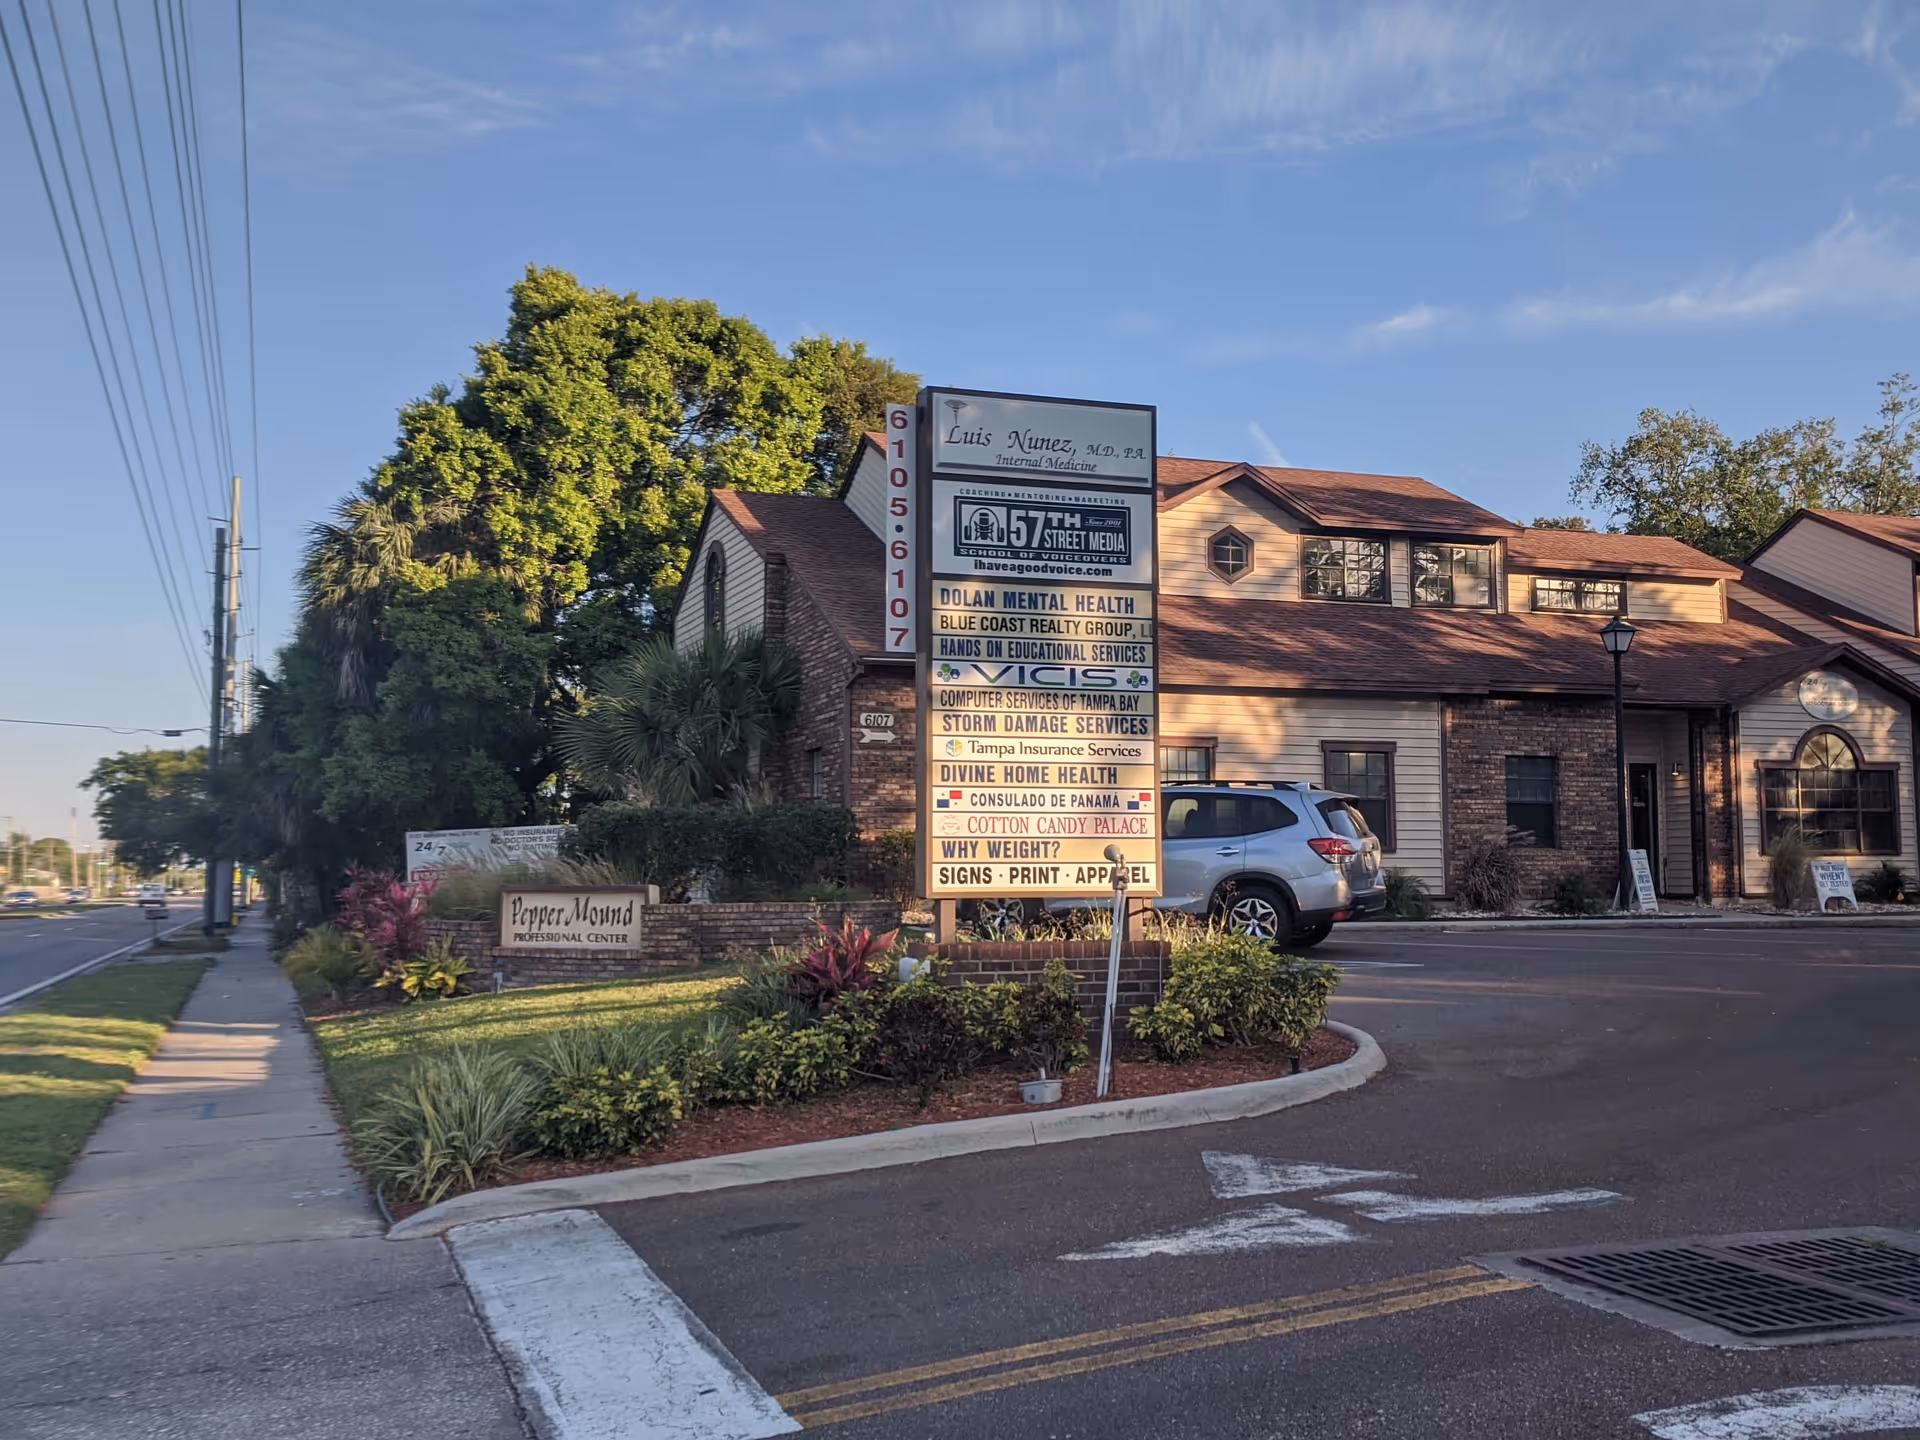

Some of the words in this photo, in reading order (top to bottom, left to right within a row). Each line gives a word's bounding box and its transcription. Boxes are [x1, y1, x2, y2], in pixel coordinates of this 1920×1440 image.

[945, 425, 992, 446] Luis
[1007, 429, 1077, 456] Nunez,
[995, 454, 1043, 469] Internal
[1045, 457, 1098, 472] Medicine
[1043, 528, 1087, 550] STREET
[1088, 531, 1125, 552] MEDIA
[959, 548, 1014, 558] SCHOOL
[1019, 551, 1036, 559] OF
[1041, 553, 1127, 564] VOICEOVERS
[973, 559, 1112, 577] ihaveagoodvoice.com
[940, 588, 995, 608] DOLAN
[1003, 591, 1068, 611] MENTAL
[1075, 594, 1135, 614] HEALTH
[940, 615, 976, 630] BLUE
[980, 616, 1026, 632] COAST
[1030, 618, 1081, 634] REALTY
[1085, 621, 1136, 640] GROUP,
[940, 638, 981, 657] HANDS
[986, 640, 1003, 658] ON
[1008, 641, 1087, 661] EDUCATIONAL
[1091, 644, 1146, 663] SERVICES
[970, 663, 1118, 687] VICIS
[940, 690, 1002, 708] COMPUTER
[1006, 691, 1059, 710] SERVICES
[1062, 693, 1078, 710] OF
[1079, 694, 1117, 711] TAMPA
[1119, 695, 1140, 712] BAY
[864, 714, 891, 727] 6107
[942, 714, 997, 732] STORM
[1004, 715, 1069, 734] DAMAGE
[1076, 716, 1149, 735] SERVICES
[967, 740, 1016, 759] Tampa
[1019, 741, 1085, 757] Insurance
[1088, 743, 1142, 758] Services
[940, 764, 996, 783] DIVINE
[1003, 766, 1050, 784] HOME
[1057, 766, 1118, 785] HEALTH
[970, 793, 1046, 808] CONSULADO
[1050, 794, 1067, 807] DE
[1070, 792, 1121, 809] PANAMÁ
[967, 816, 1030, 834] COTTON
[1036, 817, 1088, 834] CANDY
[1093, 817, 1149, 835] PALACE
[941, 840, 979, 859] WHY
[987, 840, 1061, 859] WEIGHT?
[939, 866, 993, 885] SIGNS
[1009, 866, 1061, 885] PRINT
[512, 896, 565, 932] Pepper
[564, 896, 633, 927] Mound
[513, 933, 583, 942] PROFESSIONAL
[587, 932, 628, 943] CENTER
